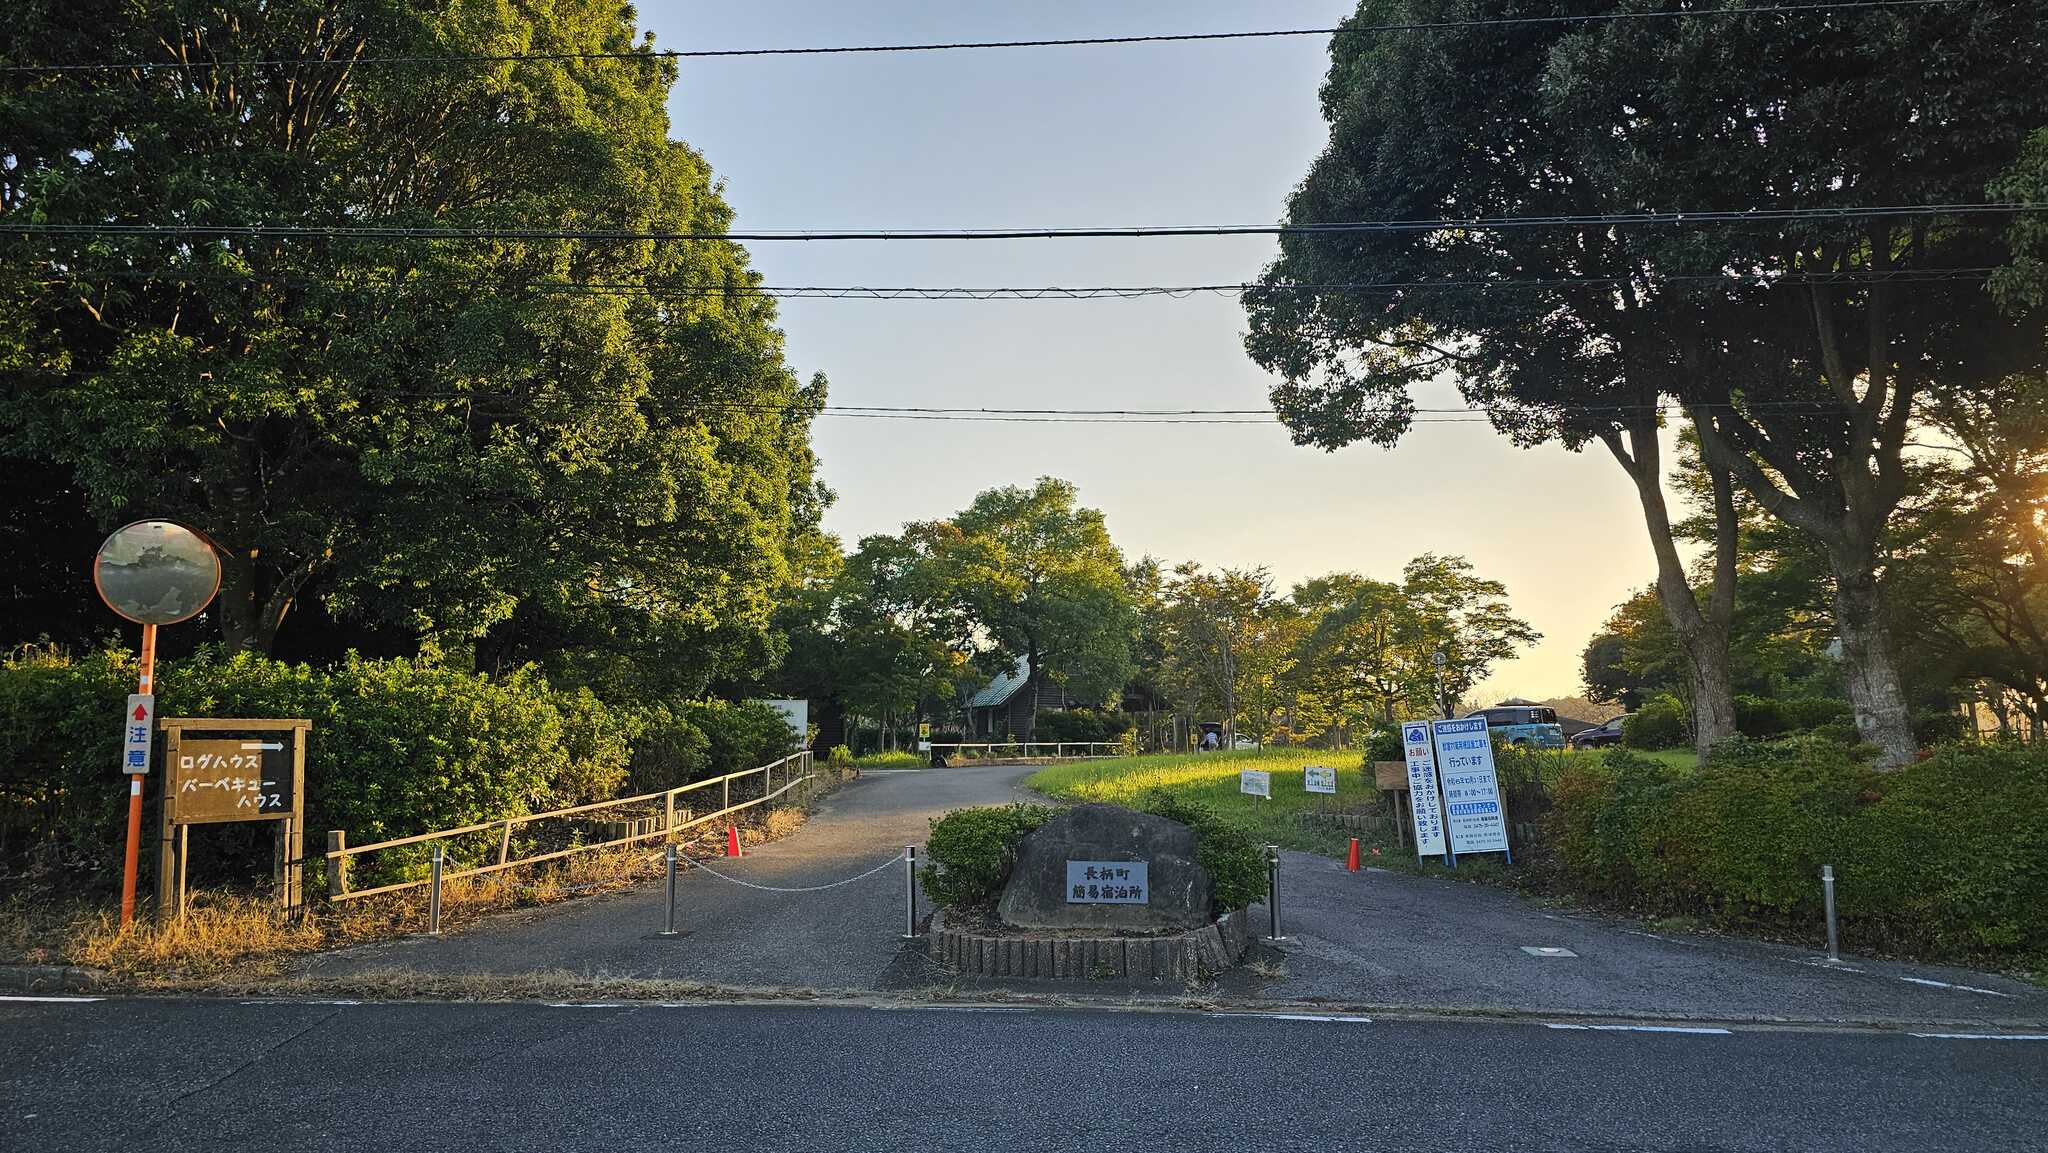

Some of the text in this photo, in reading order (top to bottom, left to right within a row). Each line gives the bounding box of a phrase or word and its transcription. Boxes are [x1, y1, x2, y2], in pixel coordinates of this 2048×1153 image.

[127, 726, 148, 767] 注意
[1408, 747, 1430, 757] お願い
[180, 754, 259, 770] ログハウス
[1448, 756, 1483, 768] 行っています
[237, 793, 282, 808] ハウス
[1084, 866, 1130, 881] 長柄町
[1072, 884, 1142, 900] 簡易宿泊所
